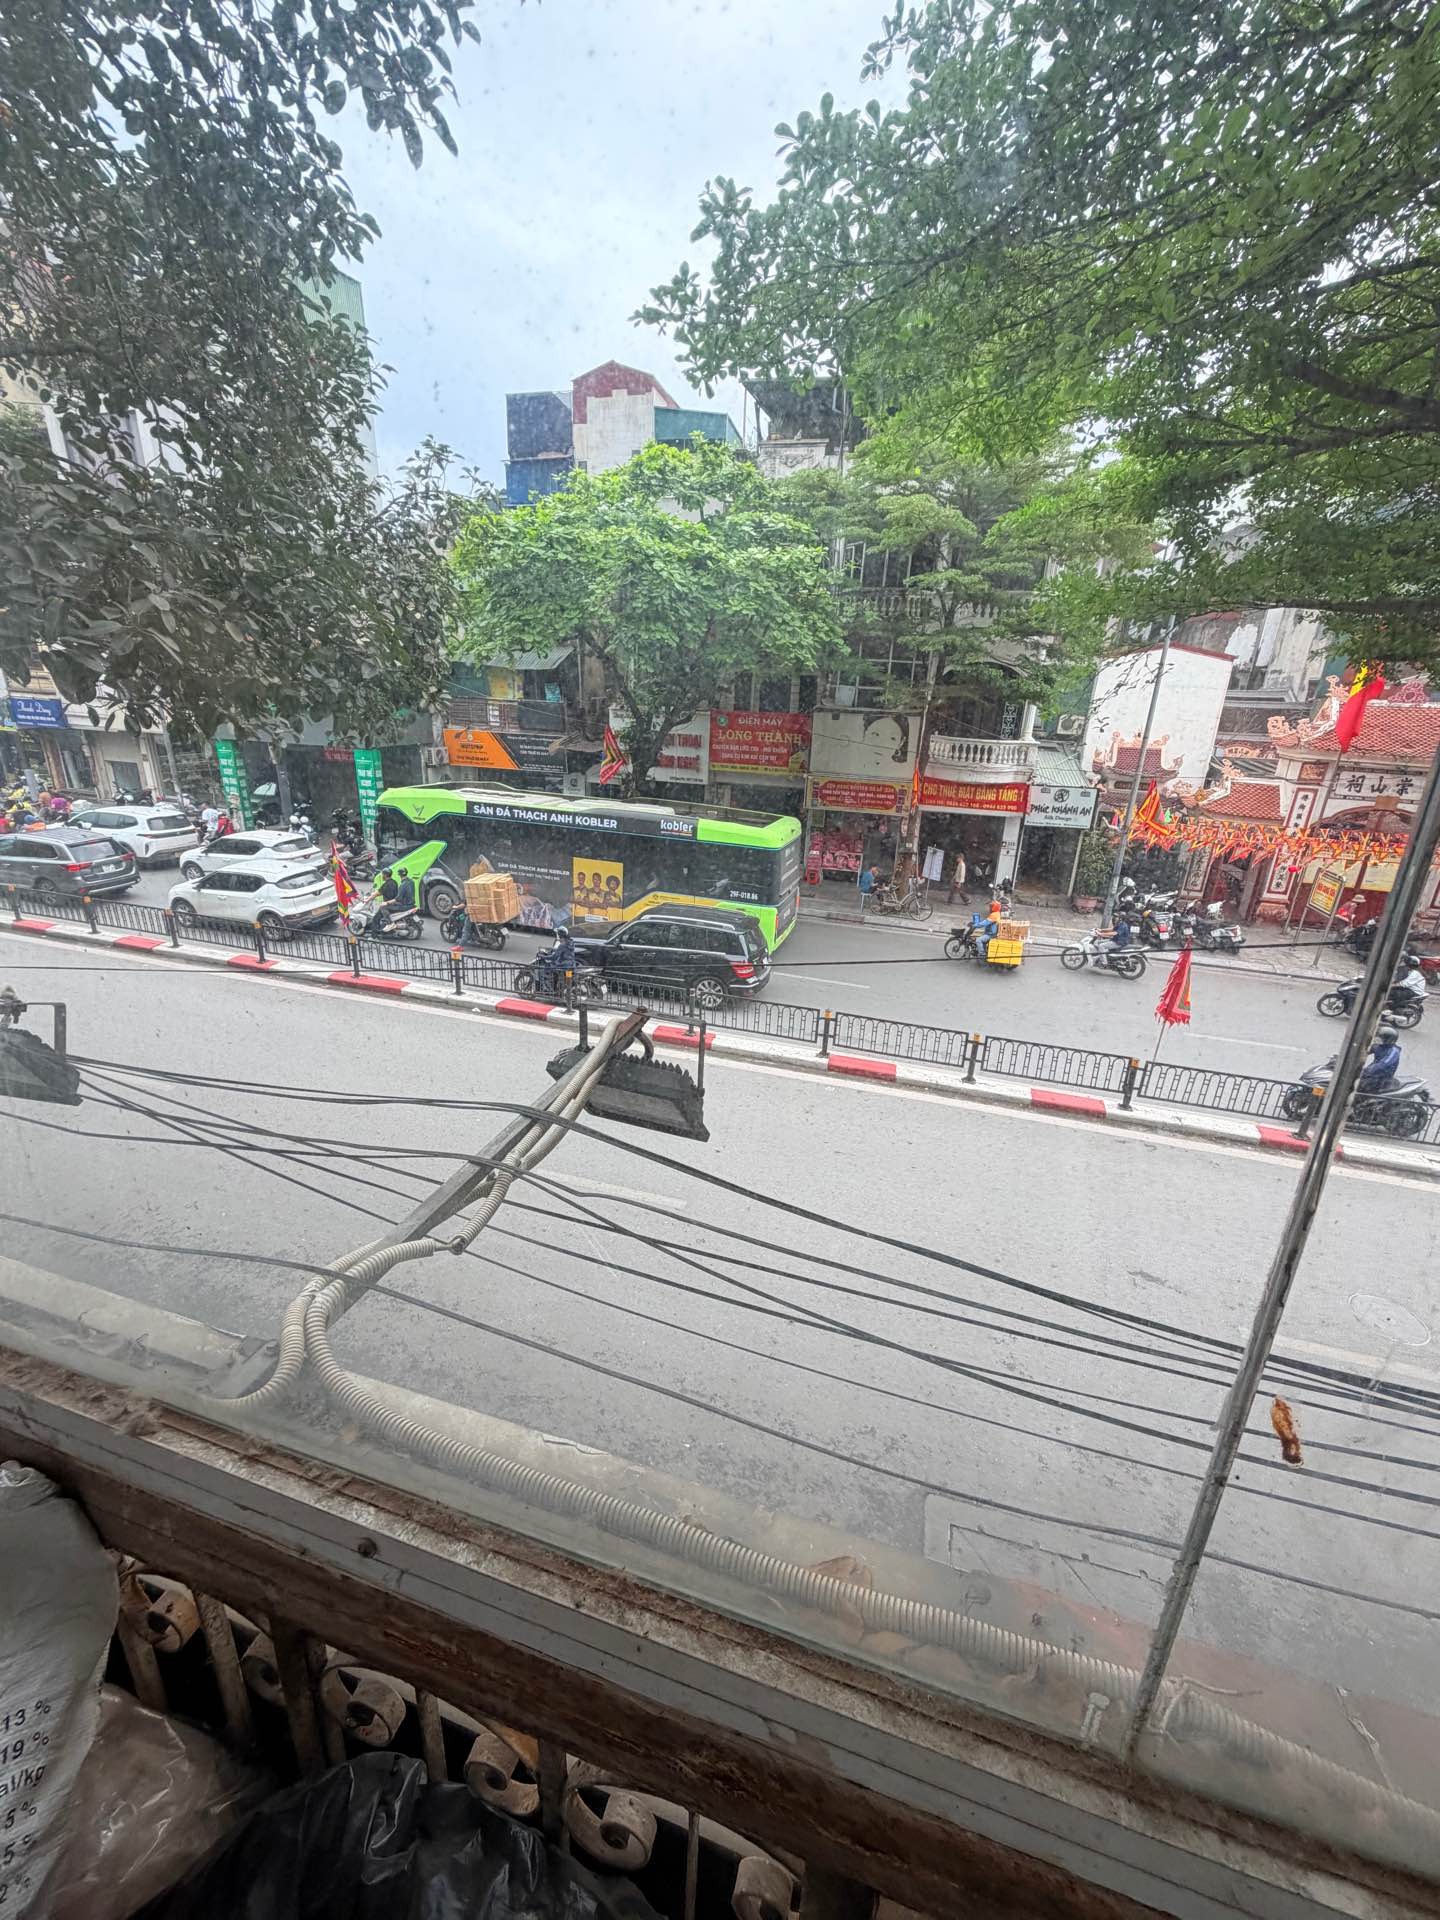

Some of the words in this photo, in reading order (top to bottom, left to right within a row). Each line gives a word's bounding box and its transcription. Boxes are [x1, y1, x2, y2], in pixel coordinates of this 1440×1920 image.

[717, 729, 753, 740] LONG
[923, 783, 938, 796] CHO
[496, 806, 511, 817] ĐÁ
[512, 809, 548, 822] THẠCH
[549, 813, 573, 824] ANH
[575, 815, 618, 829] KOBLER
[1079, 806, 1092, 816] AN
[660, 819, 694, 832] kobler
[3, 1708, 25, 1731] 13
[34, 1700, 51, 1714] %
[0, 1739, 24, 1764] 19
[32, 1731, 49, 1745] %
[21, 1801, 37, 1816] %
